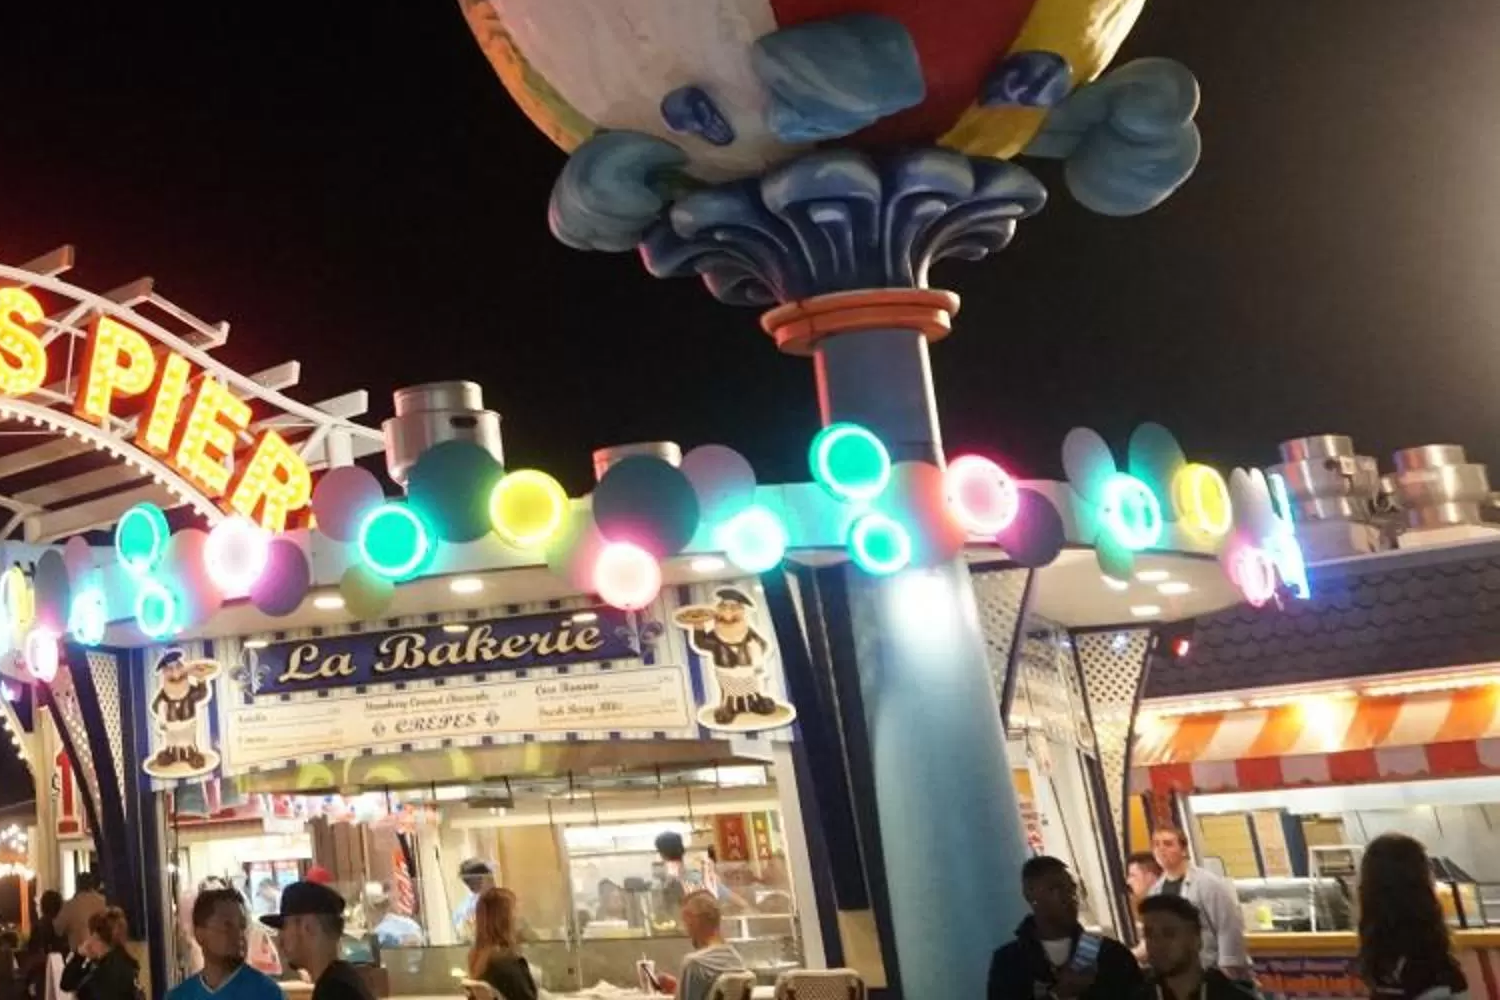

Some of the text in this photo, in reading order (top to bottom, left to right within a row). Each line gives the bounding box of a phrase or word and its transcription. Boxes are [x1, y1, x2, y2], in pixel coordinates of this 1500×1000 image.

[75, 311, 318, 534] PIER
[278, 619, 604, 684] La Bakerie
